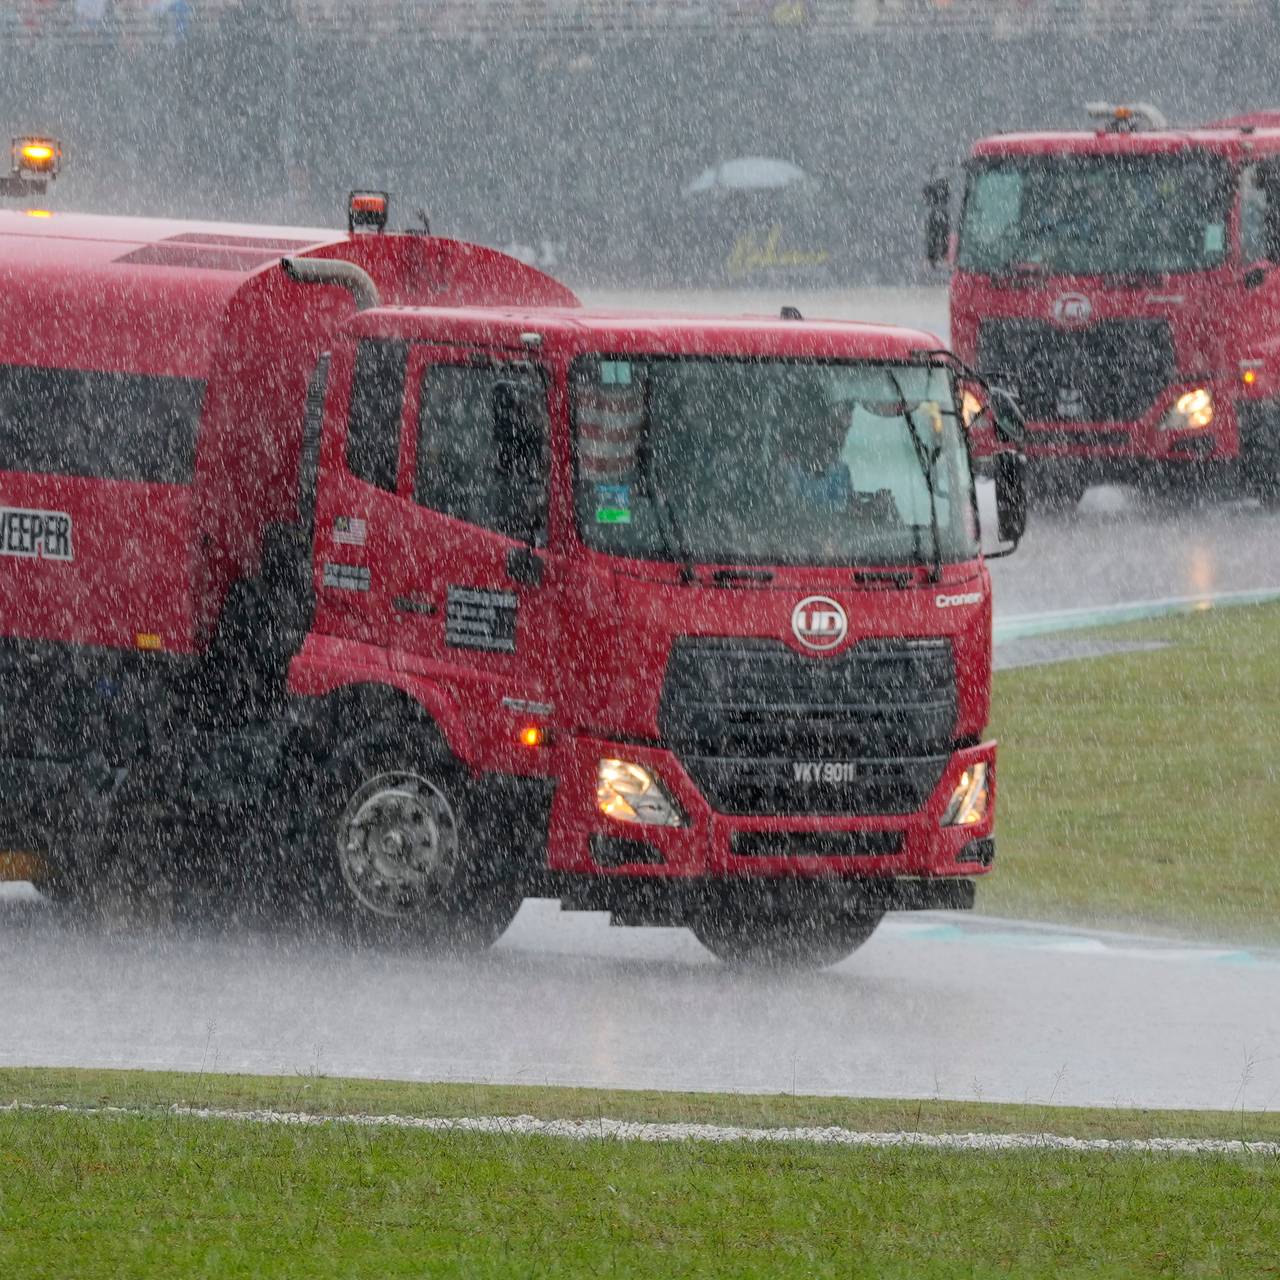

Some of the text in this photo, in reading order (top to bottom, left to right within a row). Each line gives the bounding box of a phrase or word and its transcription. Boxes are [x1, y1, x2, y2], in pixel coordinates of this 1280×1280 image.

[935, 592, 982, 609] Croner
[797, 610, 843, 635] UD
[824, 761, 855, 782] 9011
